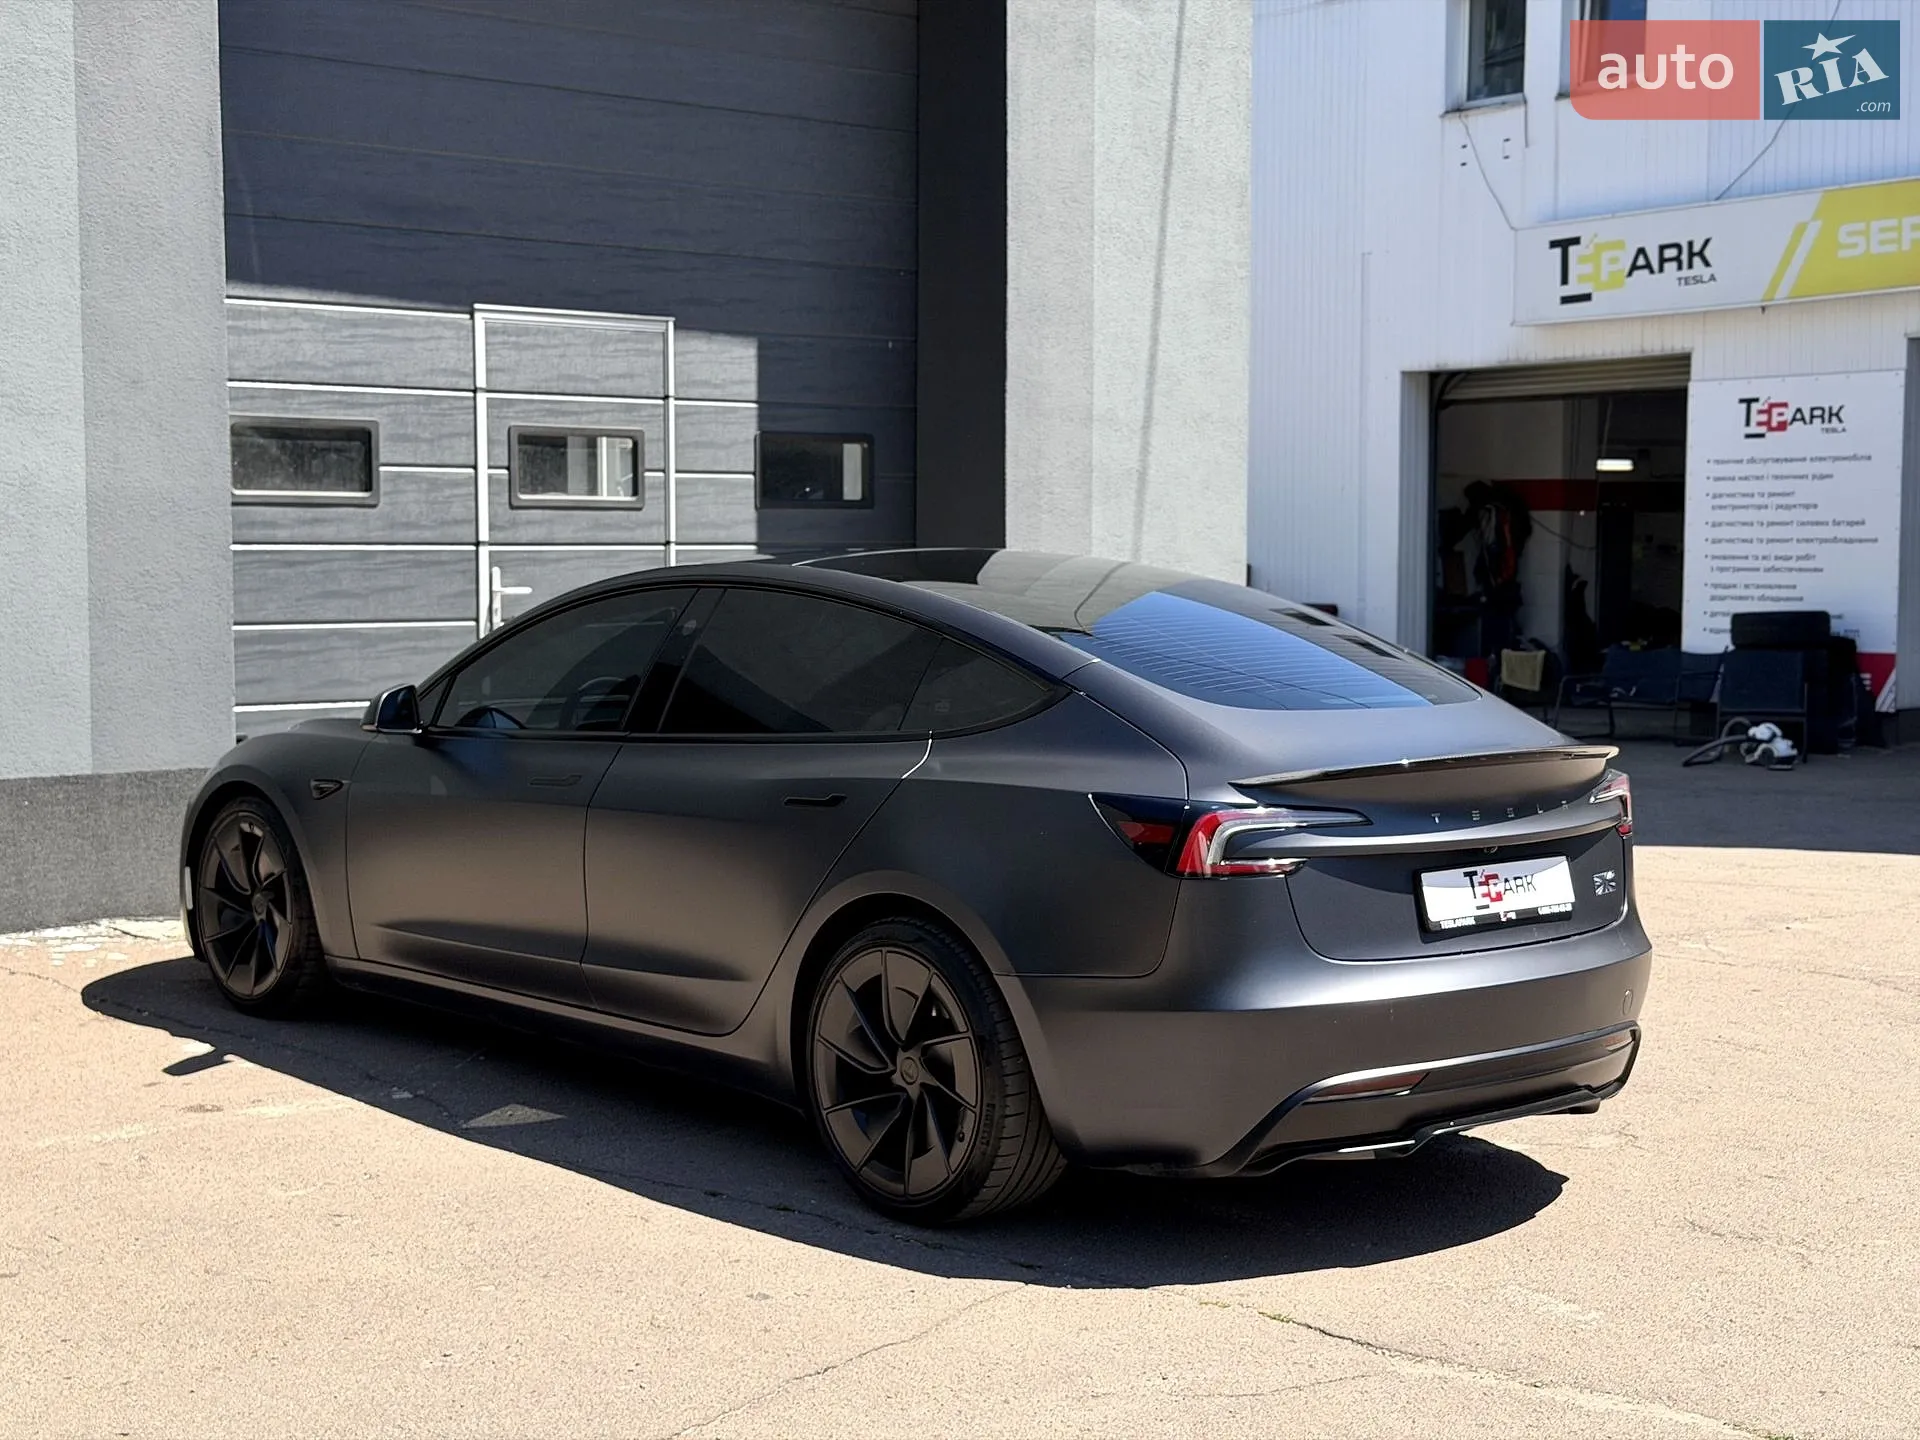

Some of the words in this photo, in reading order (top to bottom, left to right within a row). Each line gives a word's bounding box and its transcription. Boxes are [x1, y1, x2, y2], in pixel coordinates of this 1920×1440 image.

[1676, 273, 1717, 287] TESLA
[1820, 426, 1847, 434] TESLA
[1431, 800, 1569, 824] TESLA
